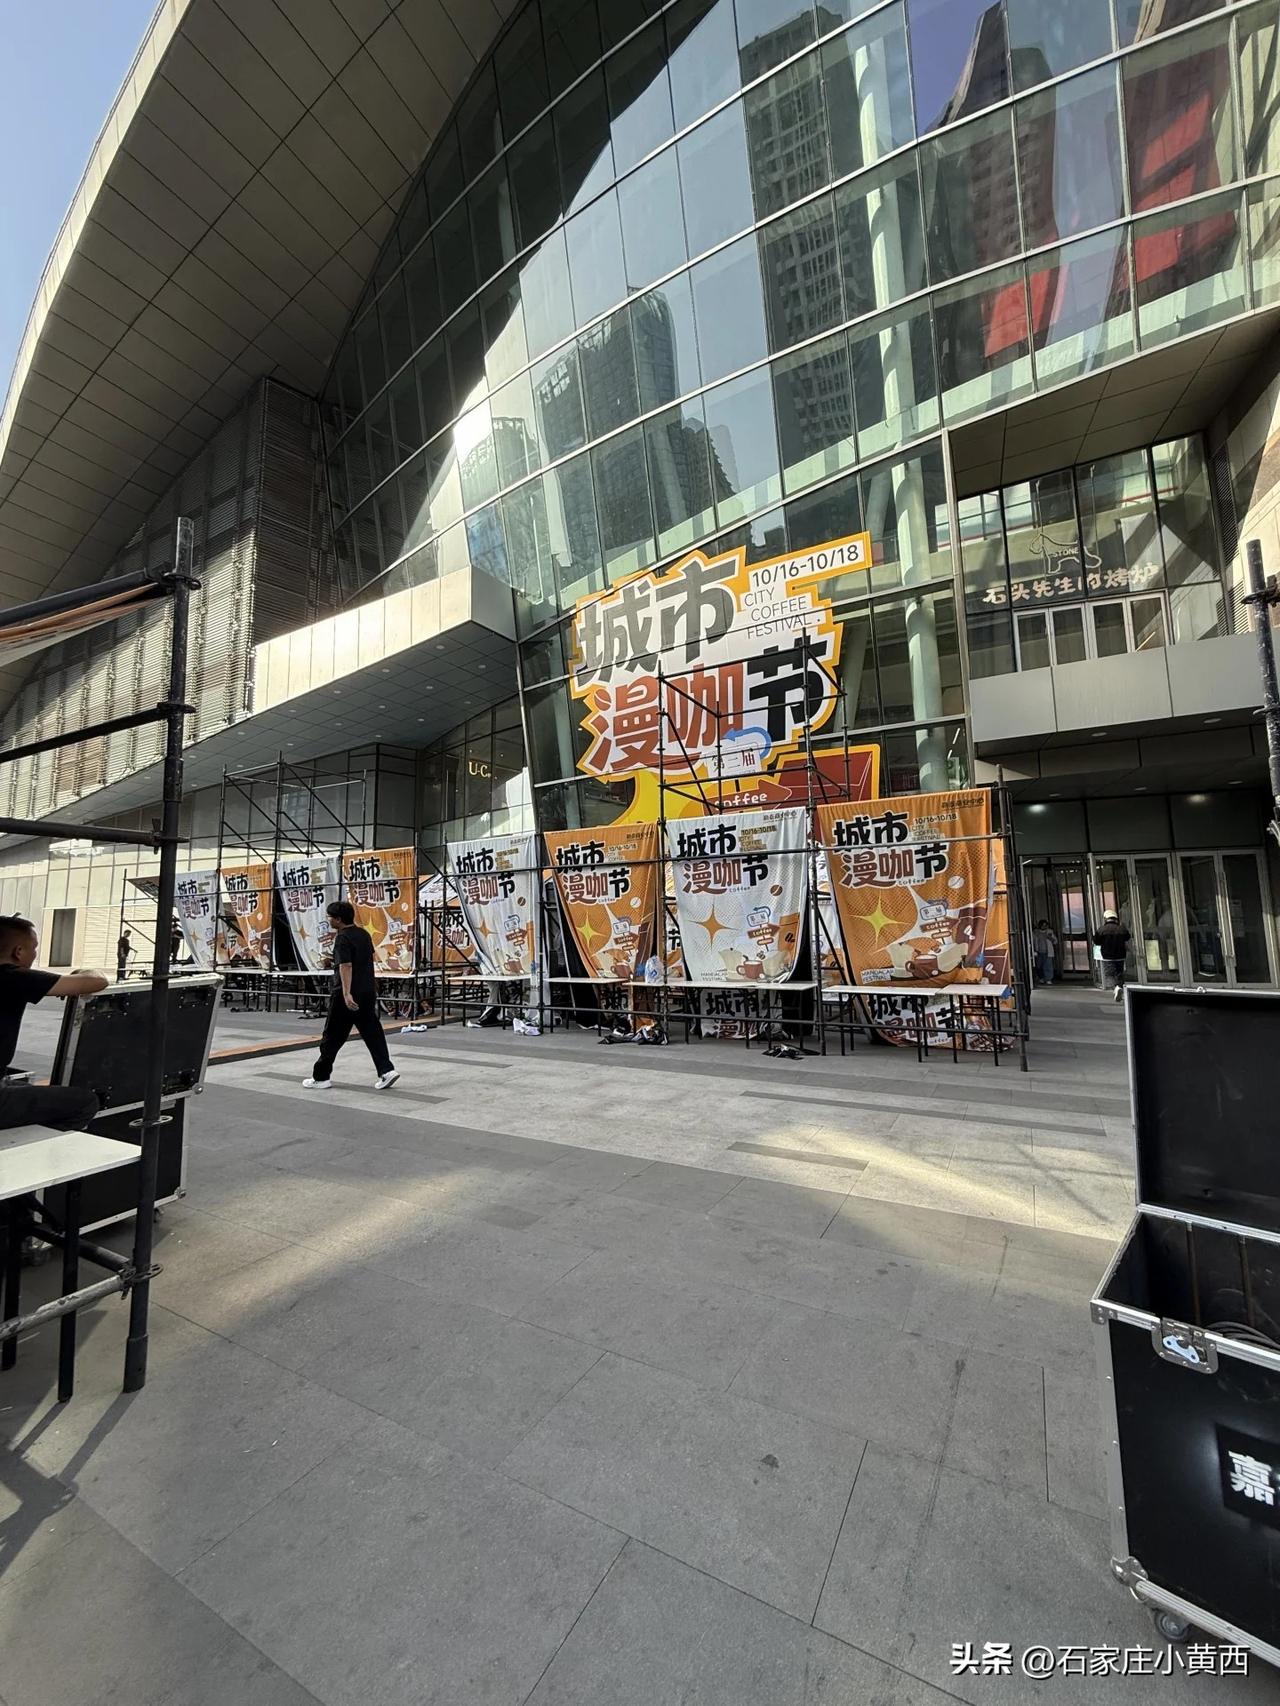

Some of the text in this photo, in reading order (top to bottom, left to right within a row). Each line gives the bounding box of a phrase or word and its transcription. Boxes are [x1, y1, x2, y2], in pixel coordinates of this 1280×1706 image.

[753, 545, 859, 587] 10/16-10/18
[744, 587, 775, 607] CITY
[751, 596, 807, 622] COFFEE
[577, 559, 736, 686] 城市
[747, 613, 812, 639] FESTIVAL
[589, 635, 827, 772] 漫咖节
[834, 811, 908, 854] 城市
[914, 813, 957, 824] 10/16-10/18
[556, 840, 605, 873] 城市
[677, 824, 737, 861] 城市
[282, 865, 310, 888] 城市
[349, 857, 380, 881] 城市
[456, 848, 493, 879] 城市
[682, 854, 769, 894] 漫咖节
[841, 843, 946, 887] 漫咖节
[288, 886, 324, 913] 漫咖节
[354, 880, 400, 907] 漫咖节
[462, 872, 515, 905] 漫咖节
[562, 867, 630, 904] 漫咖节
[1228, 1451, 1280, 1505] 嘉
